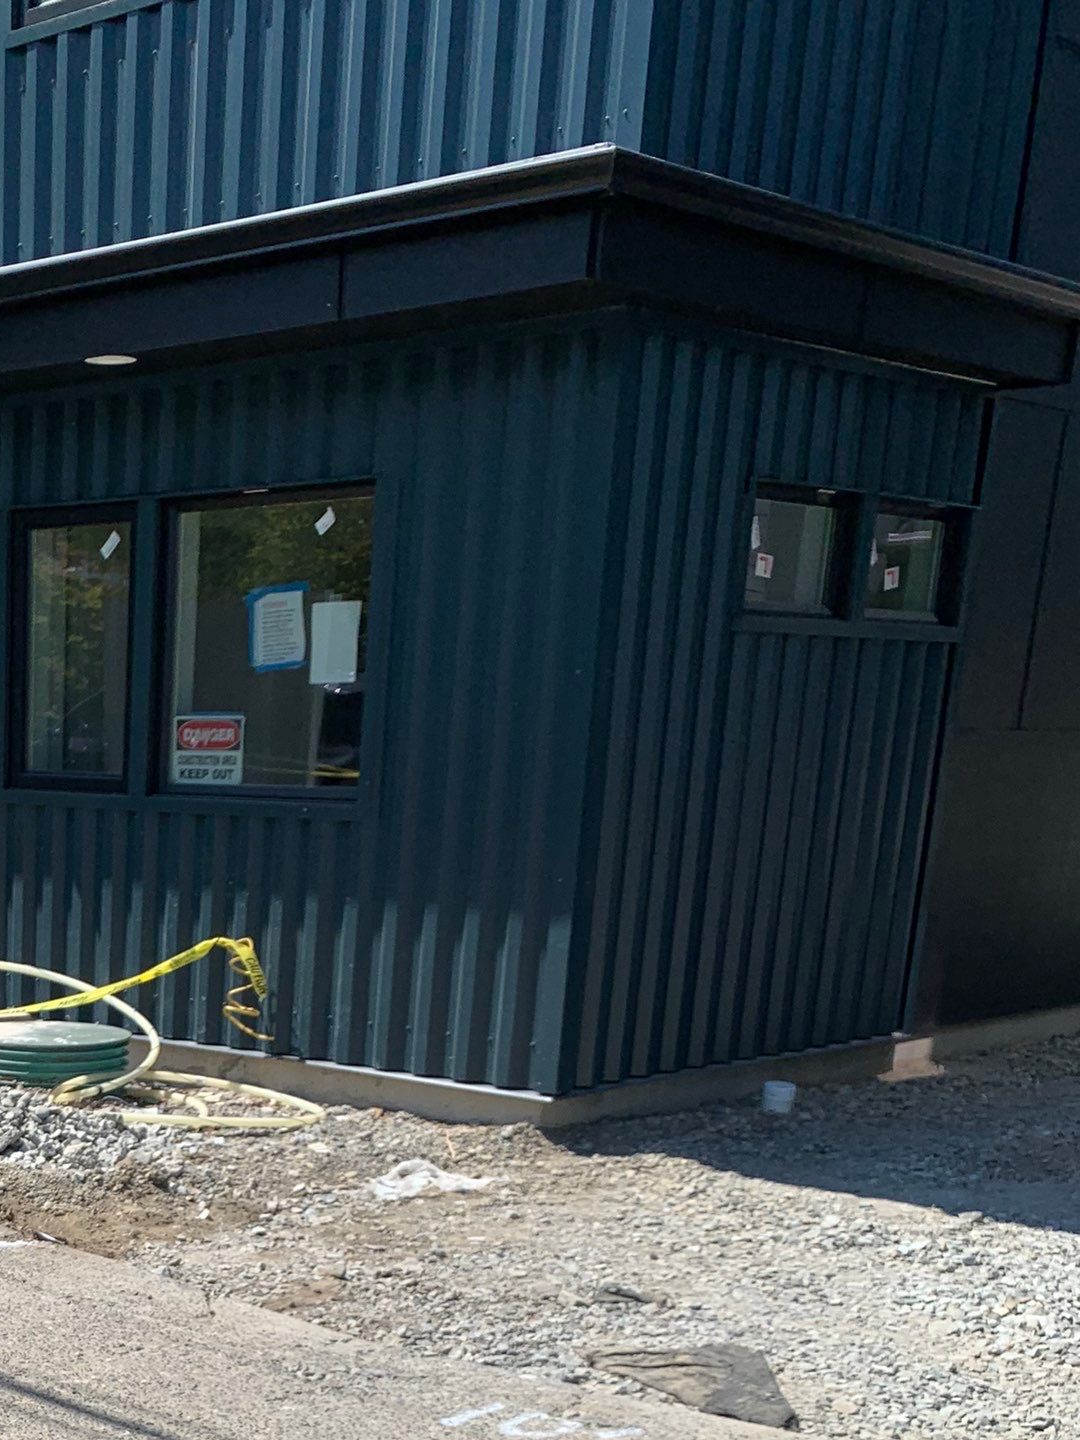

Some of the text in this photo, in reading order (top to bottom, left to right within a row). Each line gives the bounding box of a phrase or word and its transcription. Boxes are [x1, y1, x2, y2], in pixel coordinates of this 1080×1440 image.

[183, 727, 235, 742] DANGER
[180, 768, 235, 779] KEEP OUT
